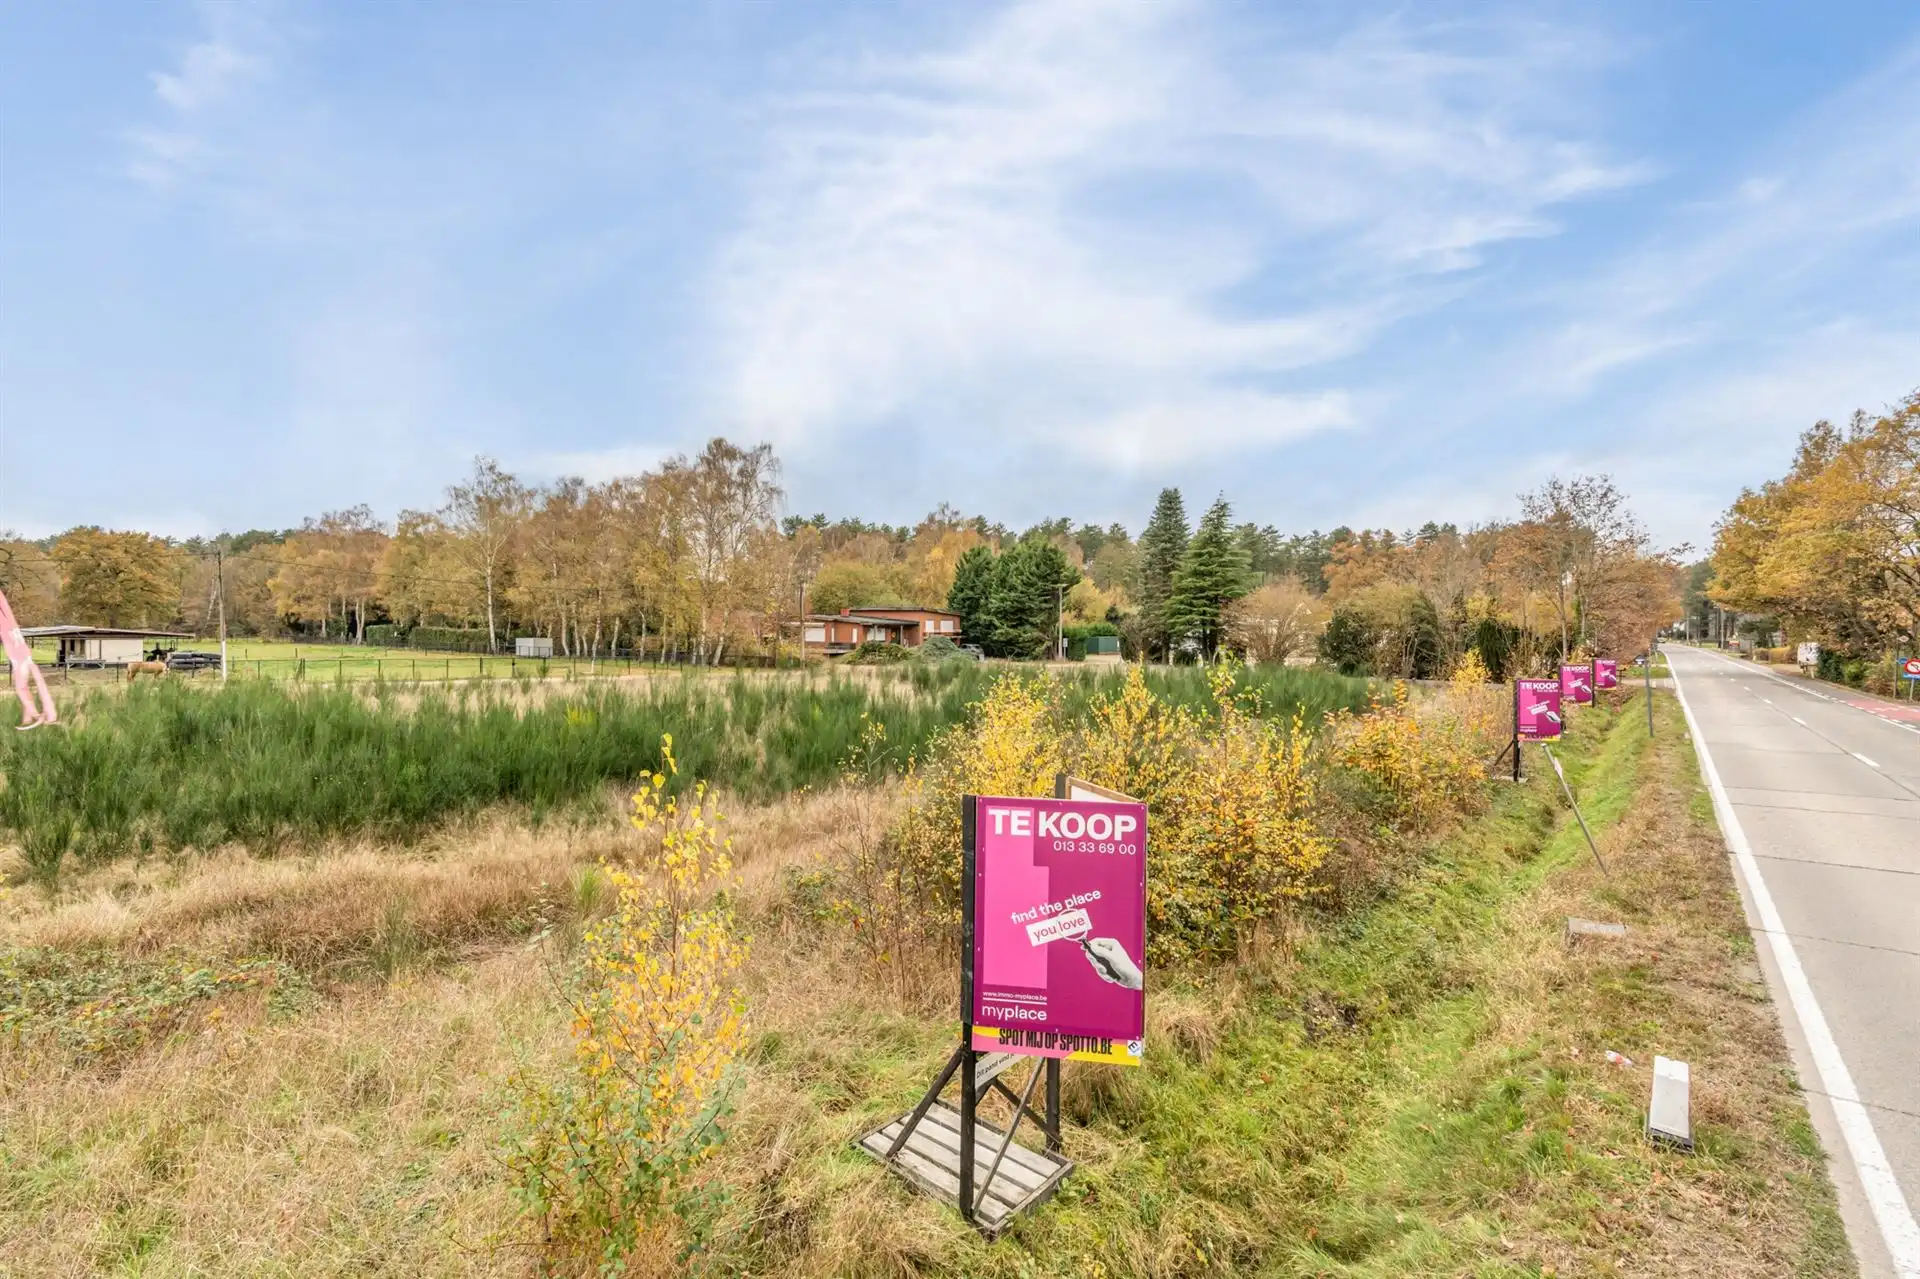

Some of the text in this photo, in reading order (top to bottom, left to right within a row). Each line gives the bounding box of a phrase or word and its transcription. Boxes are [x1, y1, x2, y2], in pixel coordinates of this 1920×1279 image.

[1520, 682, 1559, 690] TE KOOP
[988, 809, 1137, 841] TE KOOP
[1053, 840, 1137, 855] 013 33 69 00
[1011, 890, 1102, 925] find the place
[1033, 917, 1087, 942] you love
[982, 991, 1048, 1001] www.immo-myplace.be
[982, 1005, 1048, 1021] myplace
[999, 1028, 1113, 1055] SPOT MIJ OP SPOTTO.BE
